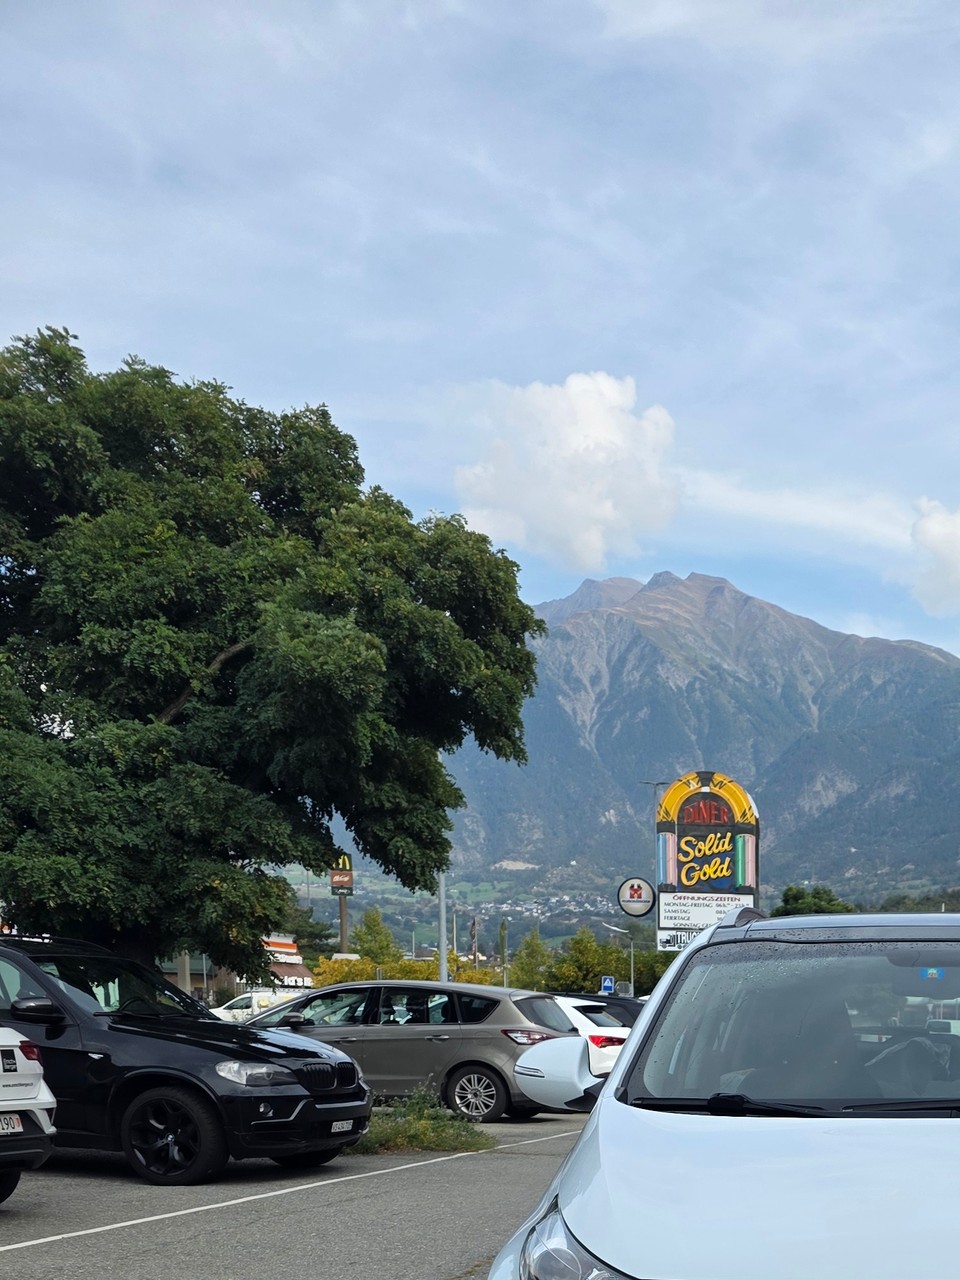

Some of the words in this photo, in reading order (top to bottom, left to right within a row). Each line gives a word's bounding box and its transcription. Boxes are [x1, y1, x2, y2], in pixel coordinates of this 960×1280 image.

[683, 801, 730, 823] DINER
[678, 832, 733, 862] Solid
[680, 857, 732, 887] Gold
[676, 931, 703, 945] TRUC
